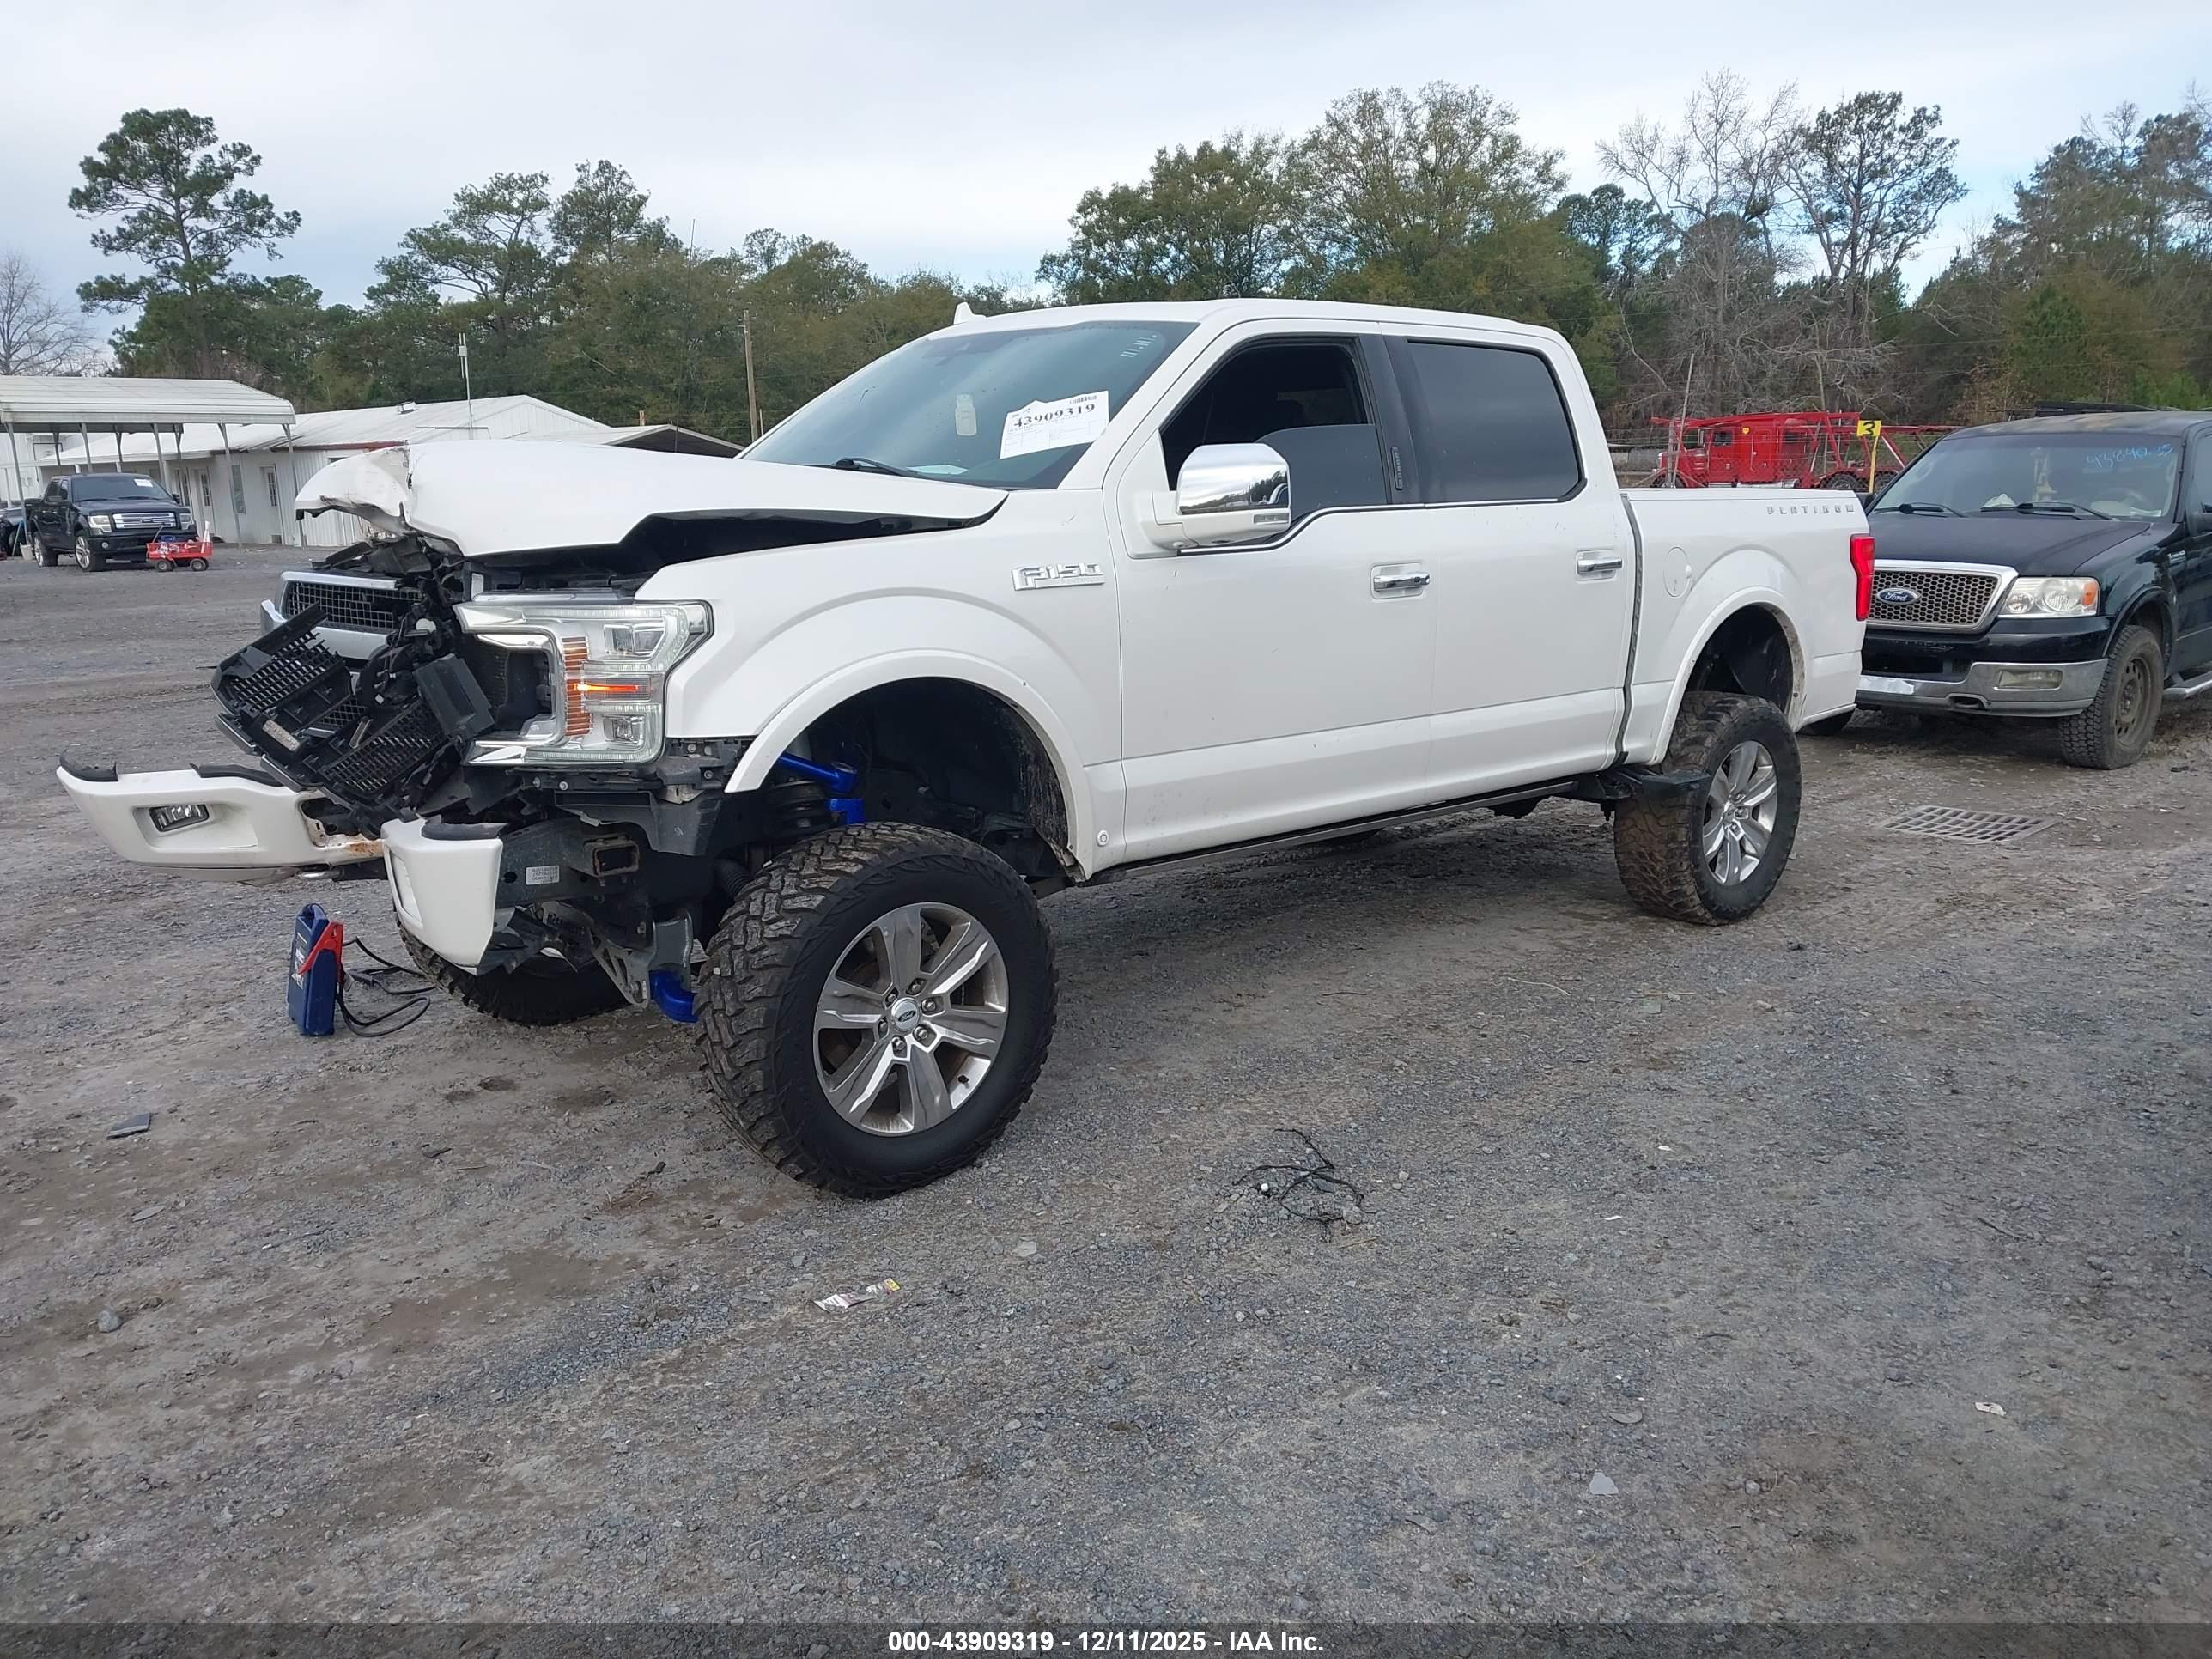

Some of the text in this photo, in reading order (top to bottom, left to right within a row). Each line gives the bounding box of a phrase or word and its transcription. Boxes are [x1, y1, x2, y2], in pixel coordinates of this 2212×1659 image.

[1013, 403, 1096, 428] 43909319
[1863, 421, 1876, 435] 3
[1766, 504, 1855, 515] PLATINUM
